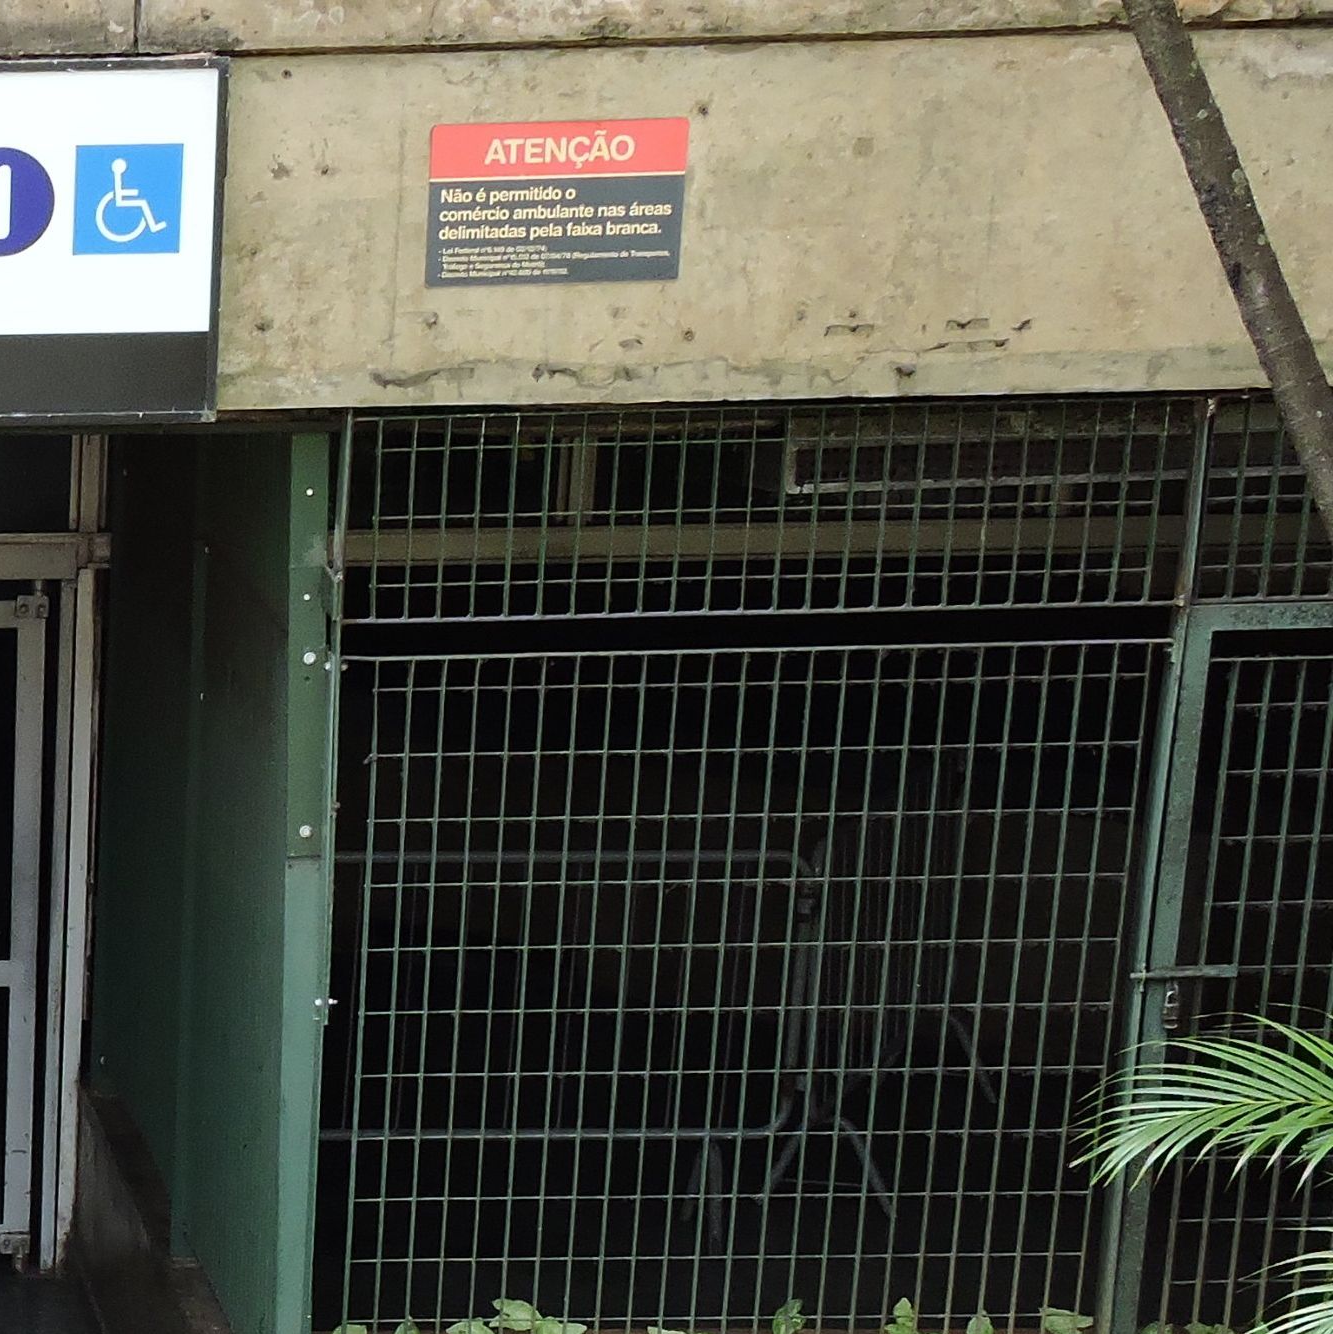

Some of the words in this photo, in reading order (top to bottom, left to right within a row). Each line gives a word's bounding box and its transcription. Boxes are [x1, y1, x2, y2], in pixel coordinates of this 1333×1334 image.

[484, 130, 635, 168] ATENÇÃO
[440, 188, 472, 203] Não
[475, 187, 486, 202] é
[489, 187, 562, 205] permitido
[565, 188, 576, 200] o
[439, 206, 509, 222] comércio
[513, 204, 593, 220] ambulante
[597, 205, 626, 217] nas
[629, 202, 672, 217] áreas
[439, 224, 526, 240] delimitadas
[529, 223, 563, 241] pela
[566, 222, 602, 237] faixa
[606, 221, 661, 236] branca.
